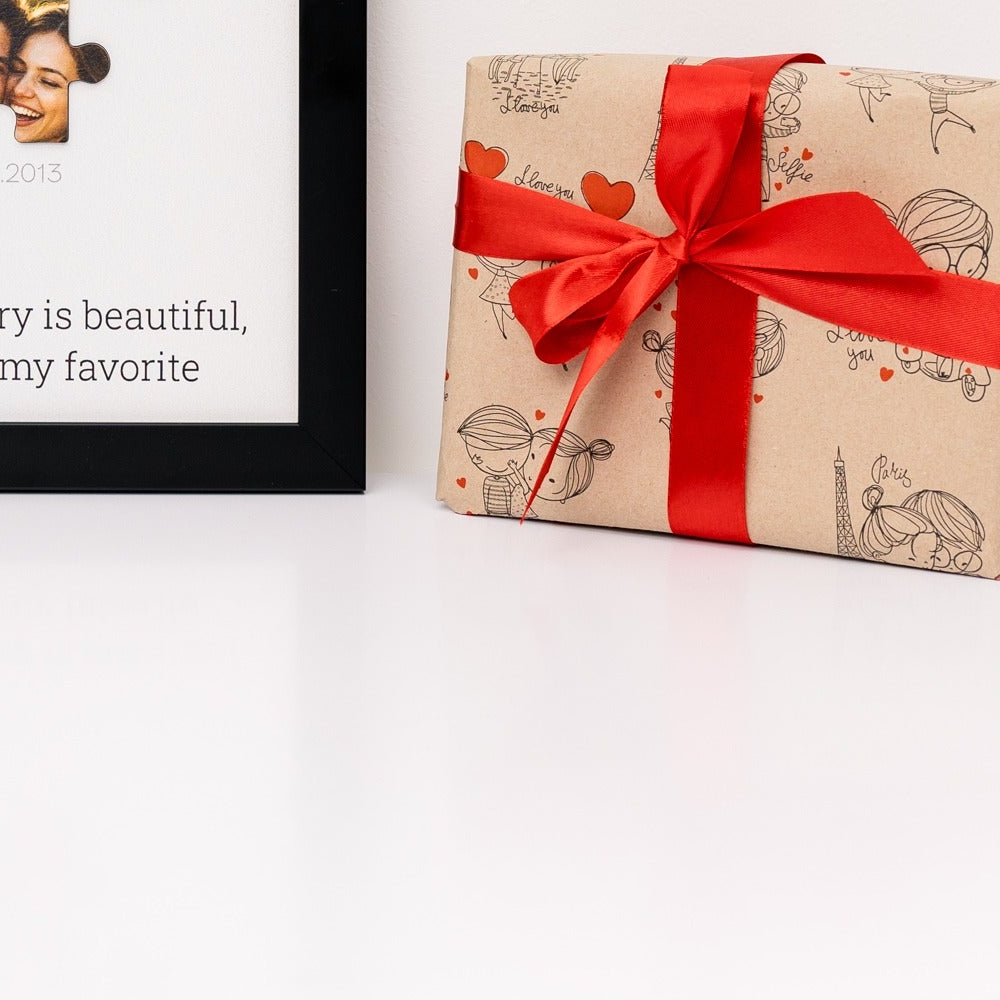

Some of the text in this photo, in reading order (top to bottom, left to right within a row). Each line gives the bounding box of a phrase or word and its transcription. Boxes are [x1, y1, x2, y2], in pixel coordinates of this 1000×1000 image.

[512, 95, 540, 113] love
[540, 102, 560, 120] you
[767, 151, 814, 184] Selfie
[526, 171, 554, 193] love
[553, 183, 575, 200] you
[44, 299, 72, 330] is
[83, 299, 248, 336] beautiful,
[64, 350, 200, 383] favorite
[847, 346, 875, 371] you
[871, 453, 912, 488] Paris
